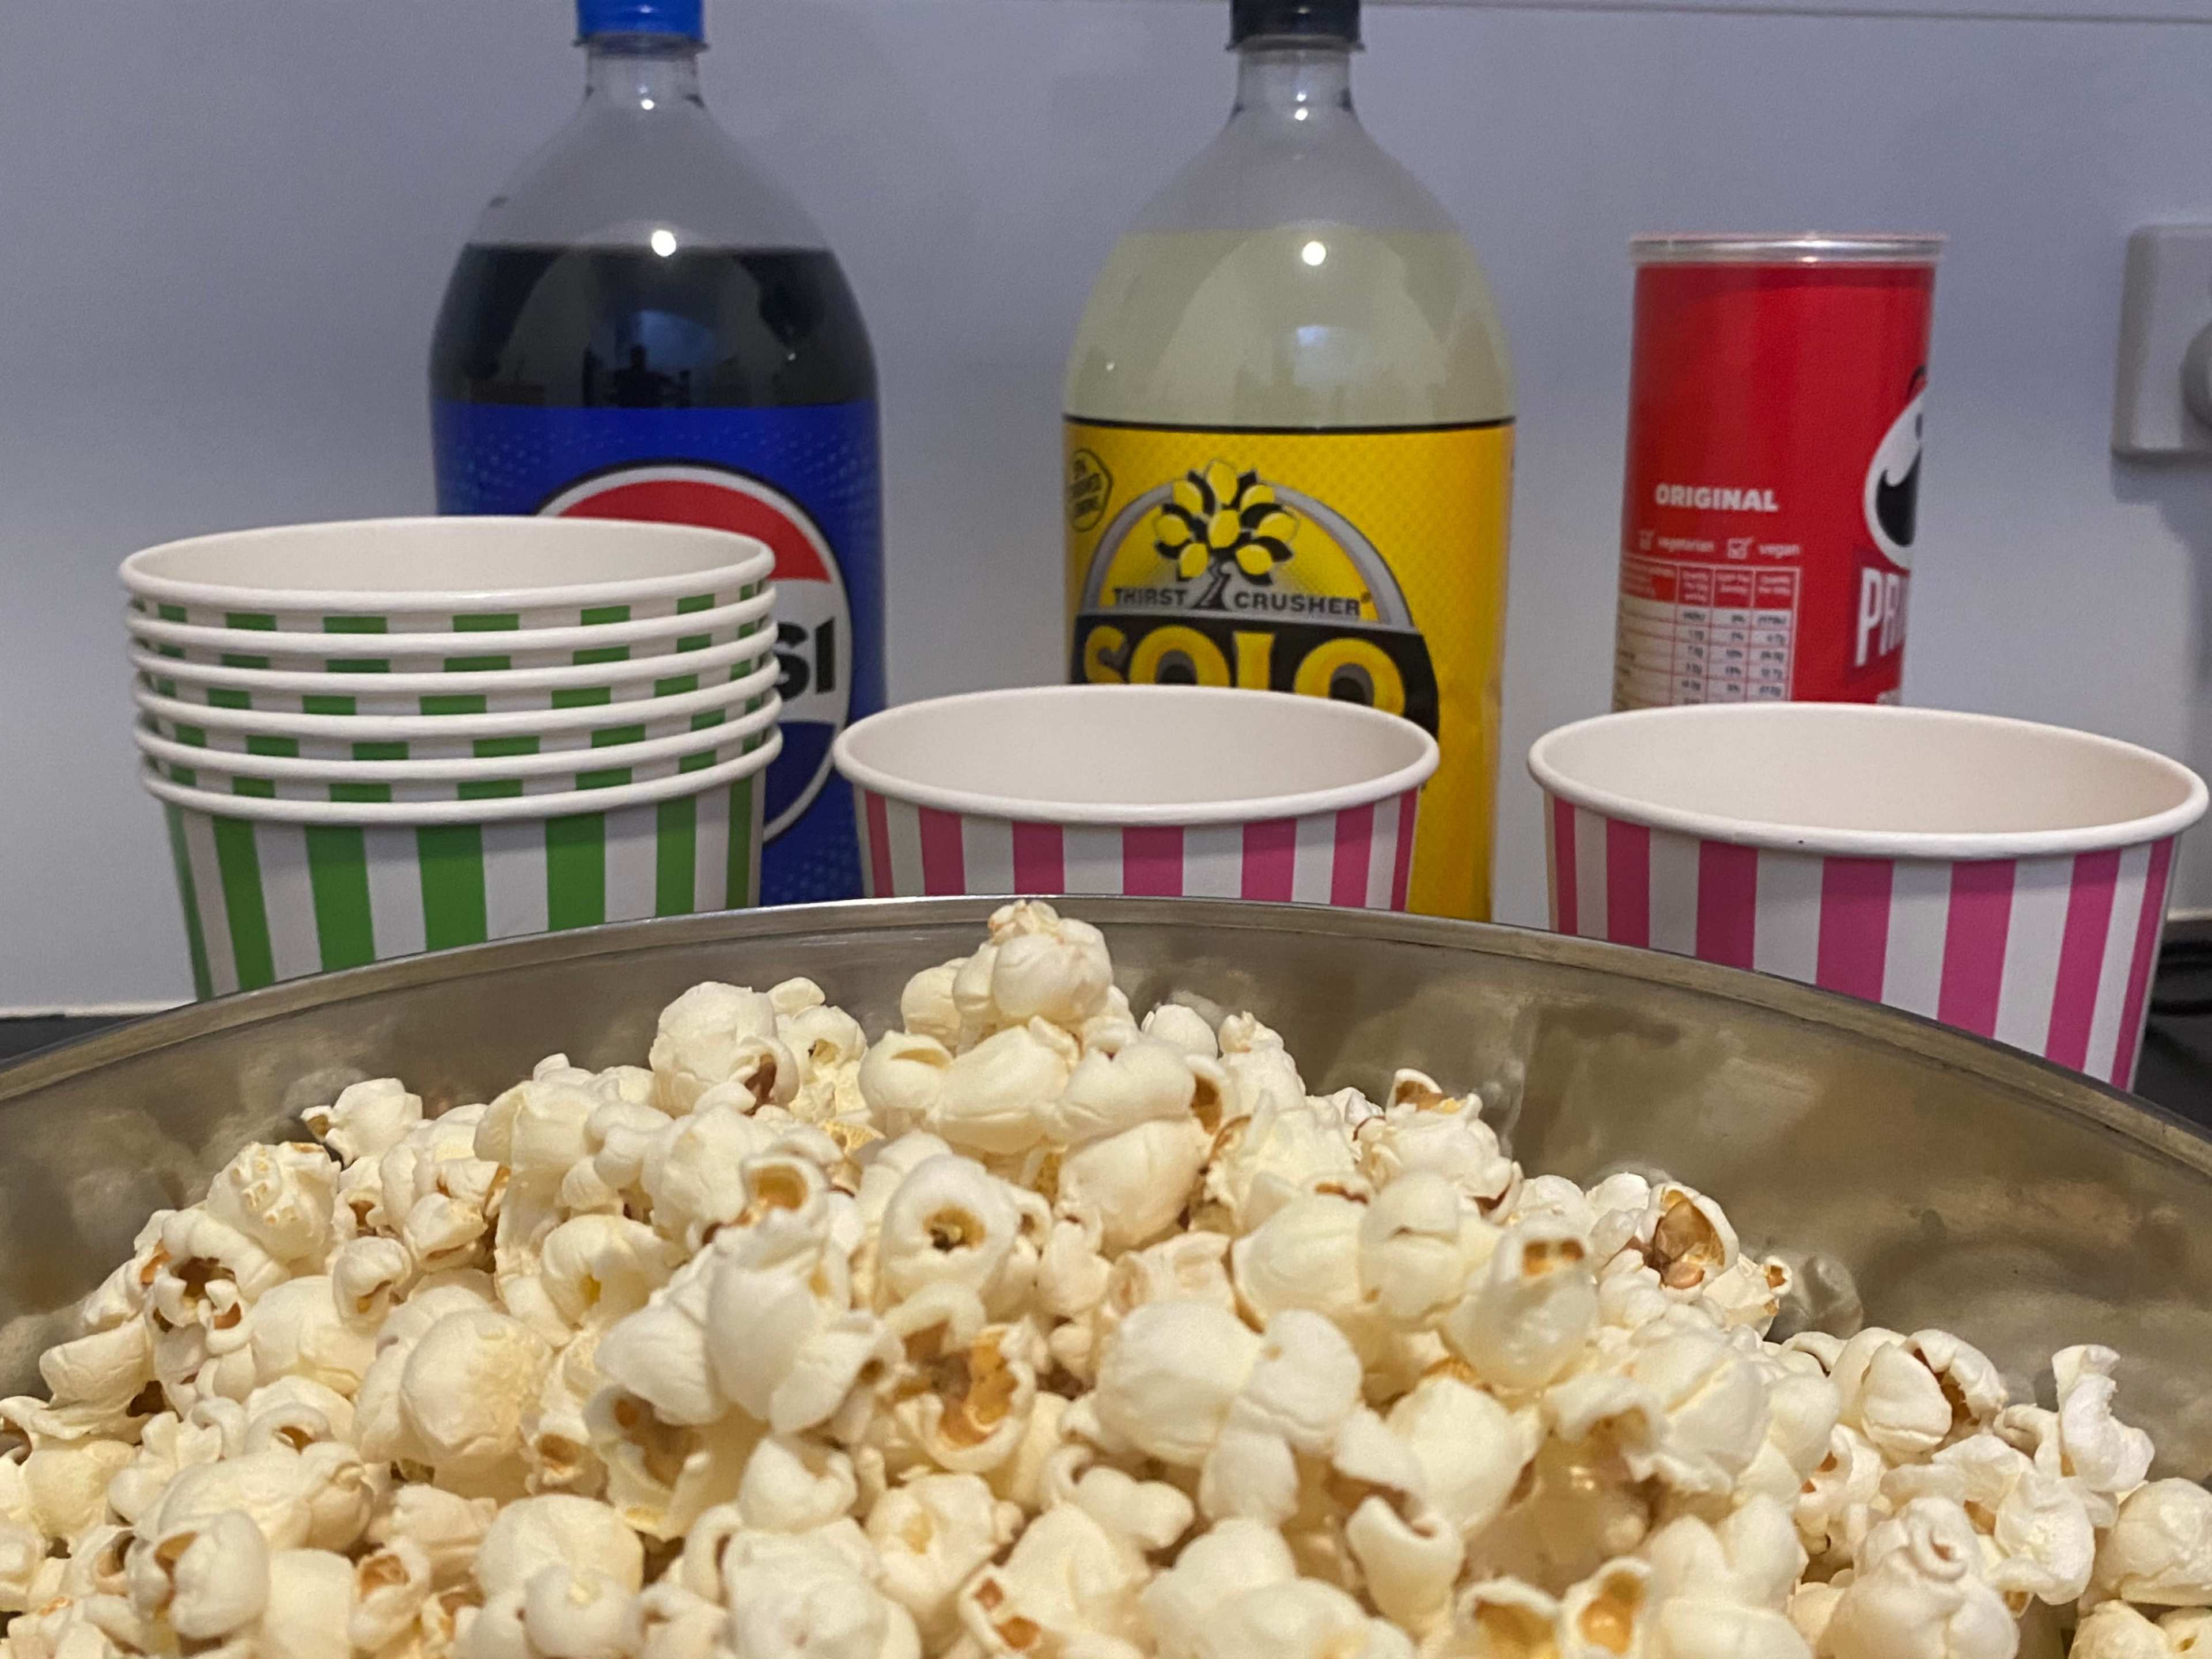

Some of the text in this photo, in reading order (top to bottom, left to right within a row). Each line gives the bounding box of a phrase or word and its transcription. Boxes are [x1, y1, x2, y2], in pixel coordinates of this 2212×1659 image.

[1655, 483, 1779, 512] ORIGINAL
[1759, 544, 1801, 559] vegan
[1113, 587, 1360, 616] THIRST CRUSHER
